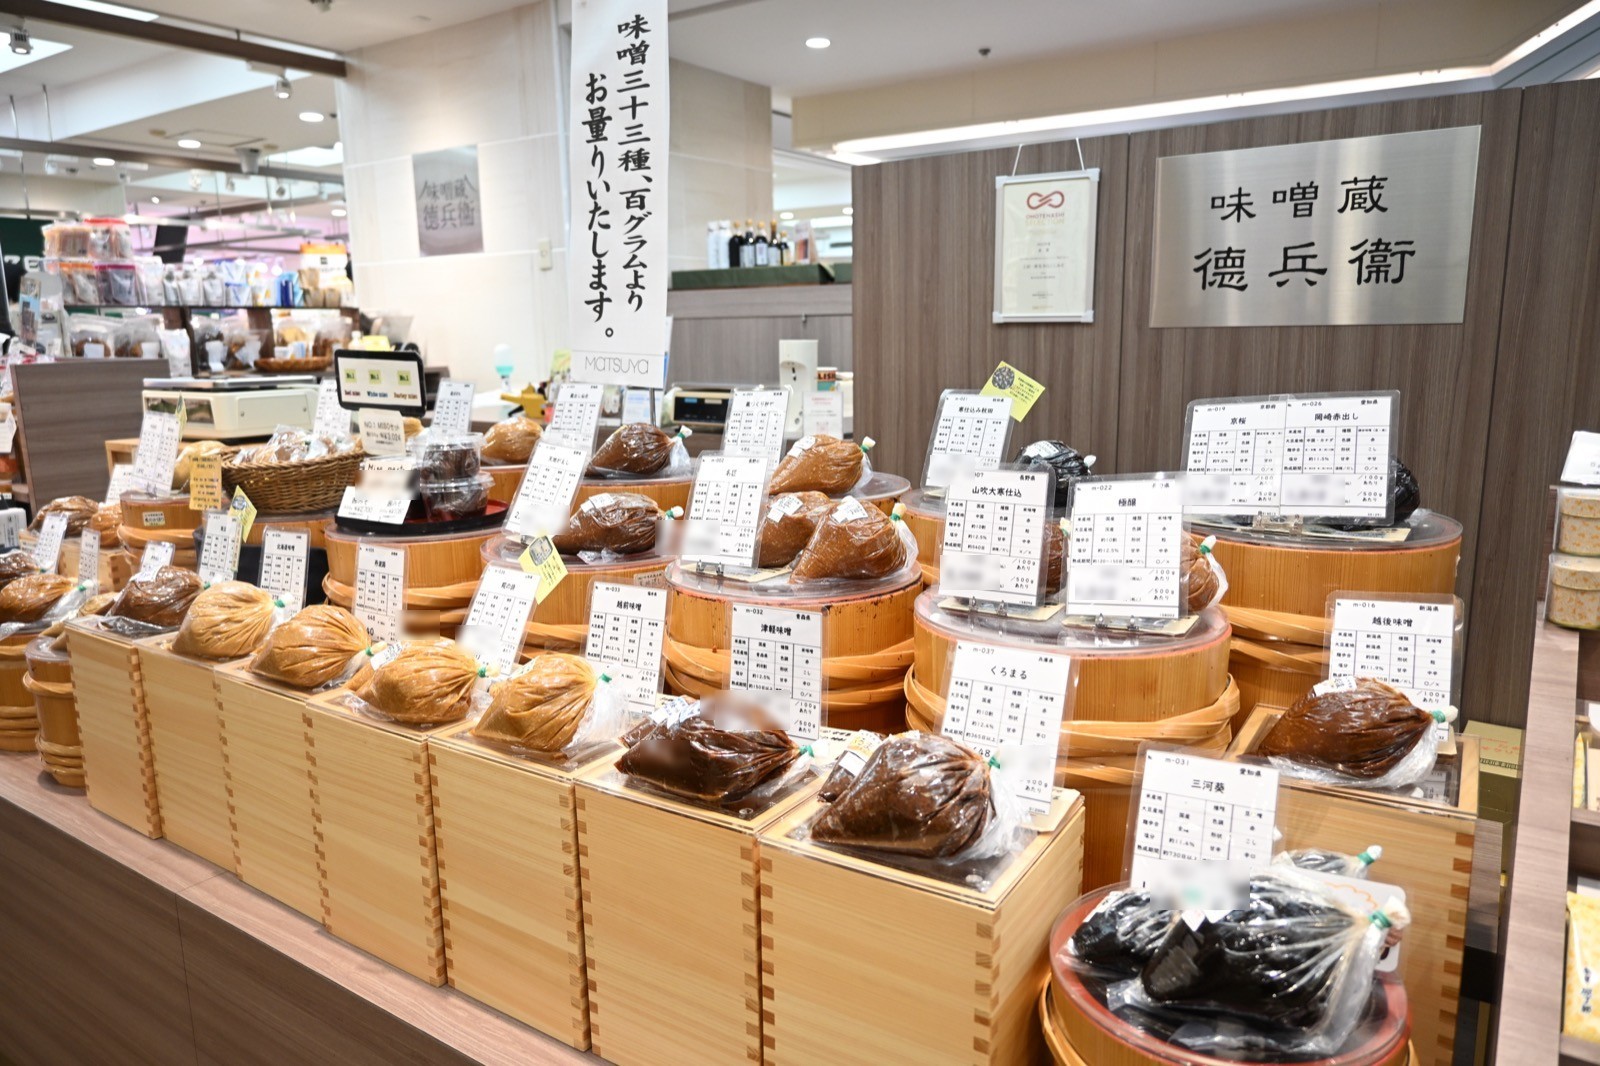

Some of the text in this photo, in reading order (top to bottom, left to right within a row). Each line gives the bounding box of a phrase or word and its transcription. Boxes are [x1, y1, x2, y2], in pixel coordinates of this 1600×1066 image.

[617, 14, 652, 312] 味噌三十三種、百グラムより
[1211, 175, 1389, 223] 味噌蔵
[582, 73, 614, 338] お量りいたします。
[972, 486, 1022, 498] 山吹大寒仕込
[1119, 498, 1136, 506] 極醸
[616, 600, 642, 611] 越前味噌
[1372, 617, 1413, 627] 越後味噌
[761, 624, 791, 636] 津軽味噌
[991, 666, 1027, 680] くろまる
[1165, 758, 1190, 766] m-031
[1191, 779, 1226, 794] 三河葵
